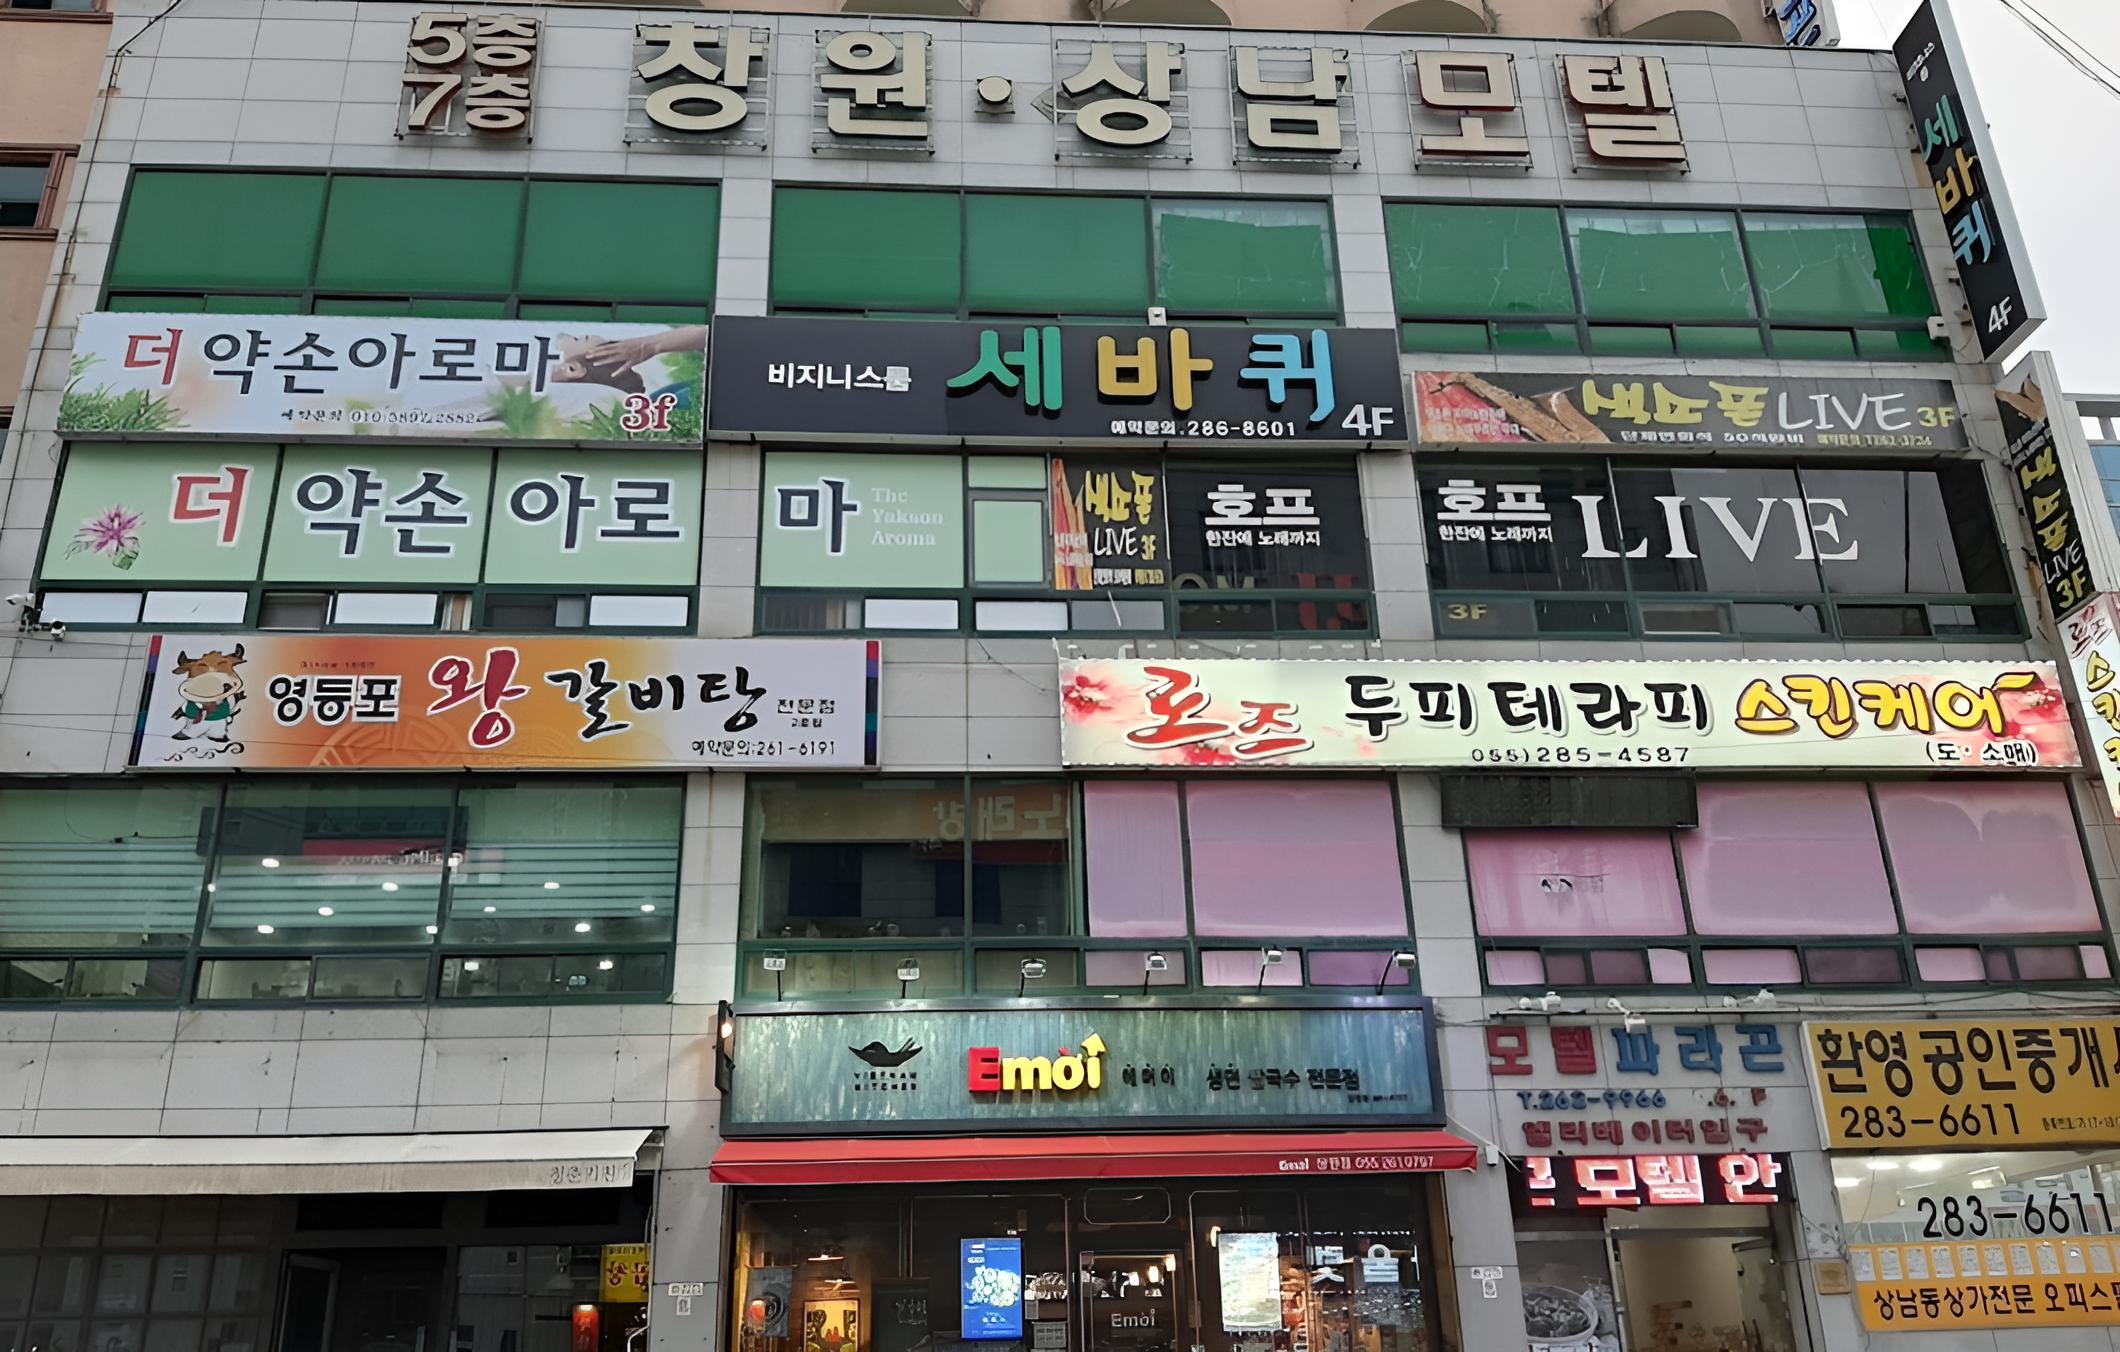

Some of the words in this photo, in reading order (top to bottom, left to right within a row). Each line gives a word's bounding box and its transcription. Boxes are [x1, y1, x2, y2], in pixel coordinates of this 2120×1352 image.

[409, 13, 534, 68] 5층
[403, 73, 530, 131] 7층
[1923, 94, 1993, 266] 세바퀴
[1988, 296, 2013, 334] 4F
[124, 328, 181, 386] 더
[203, 331, 560, 395] 약손아로마
[946, 326, 1336, 423] 세바퀴
[1341, 402, 1394, 437] 4F
[1777, 391, 1911, 430] LIVE
[1917, 406, 1955, 428] 3F
[172, 466, 248, 543] 더
[1205, 484, 1320, 525] 호프
[1437, 479, 1552, 521] 호프
[1571, 495, 1858, 562] LIVE
[1093, 526, 1138, 556] LIVE
[2043, 538, 2084, 585] LIVE
[1447, 604, 1489, 620] 3F
[2056, 566, 2088, 609] 3F
[266, 675, 401, 725] 영등포
[1128, 666, 1316, 759] 로즈
[1735, 672, 2034, 740] 스킨케어
[1840, 1103, 2021, 1139] 283-6611
[1574, 1155, 1705, 1206] 모텔
[1917, 1191, 2115, 1239] 283-6611
